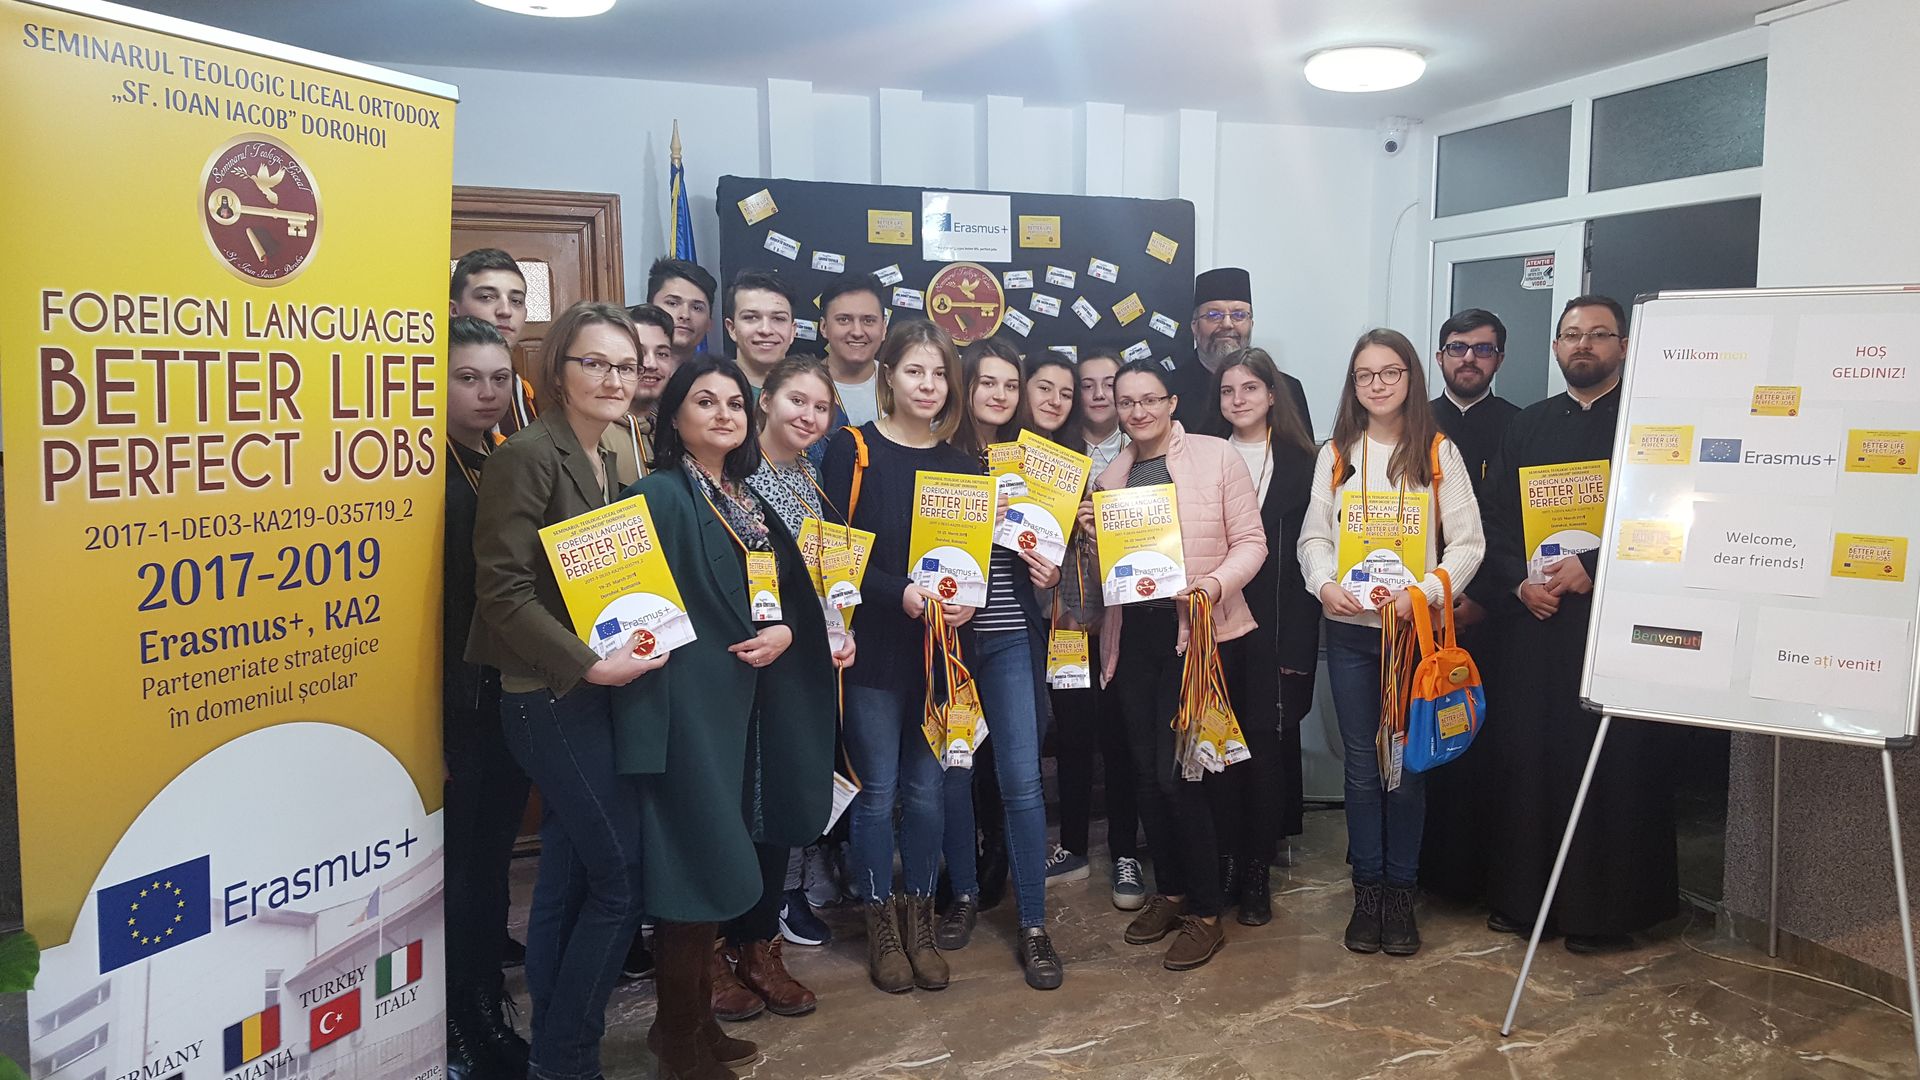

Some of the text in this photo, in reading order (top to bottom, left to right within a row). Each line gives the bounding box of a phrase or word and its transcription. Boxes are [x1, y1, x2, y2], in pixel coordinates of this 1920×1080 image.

[22, 23, 440, 130] SEMINARUL TEOLOGIC LICEAL ORTODOX
[165, 87, 219, 118] IOAN
[226, 99, 296, 130] IACOB”
[301, 114, 386, 148] DOROHOI
[953, 222, 1009, 234] Erasmus+
[41, 289, 435, 345] FOREIGN LANGUAGES
[1662, 348, 1748, 361] Willkommen
[1832, 367, 1906, 379] GELDINIZ!
[40, 346, 436, 427] BETTER LIFE
[1890, 442, 1905, 450] LIFE
[43, 427, 436, 502] PERFECT JOBS
[1049, 453, 1083, 474] LANGUAGES
[1744, 450, 1837, 466] Erasmus+
[1025, 455, 1081, 485] ETTER LIFE
[1528, 474, 1603, 487] FOREIGN LANGUAGES
[922, 486, 989, 499] FOREIGN LANGUAGES
[1053, 478, 1077, 494] JOBS
[1529, 481, 1604, 498] BETTER LIFE
[920, 493, 988, 512] BETTER LIFE
[1530, 493, 1605, 508] PERFECT JOBS
[920, 506, 988, 522] PERFECT JOBS
[1102, 503, 1171, 522] BETTER LIFE
[1103, 514, 1172, 531] PERFECT JOBS
[85, 498, 413, 551] 2017-1-DE03-KA219-035719_2
[557, 515, 643, 551] FOREIGN LANGUAGES
[1022, 519, 1060, 540] Erasmus+
[559, 524, 648, 568] BETTER LIFE
[1726, 531, 1797, 549] Welcome,
[565, 540, 652, 581] PERFECT JOBS
[1713, 552, 1805, 570] dear friends!
[1848, 548, 1892, 557] BETTER LIFE
[136, 536, 382, 612] 2017-2019
[939, 563, 978, 578] Erasmus+
[1371, 576, 1412, 585] Erasmus+
[622, 606, 671, 631] Erasmus+
[139, 594, 381, 665] Erasmus+, KA2
[1632, 629, 1702, 647] Benvenuti
[142, 636, 379, 700] Parteneriate strategice
[1777, 649, 1882, 672] Bine ați venit!
[168, 670, 359, 729] în domeniul școlar
[223, 827, 419, 927] Erasmus+
[299, 964, 368, 1010] TURKEY
[374, 985, 419, 1021] ITALY
